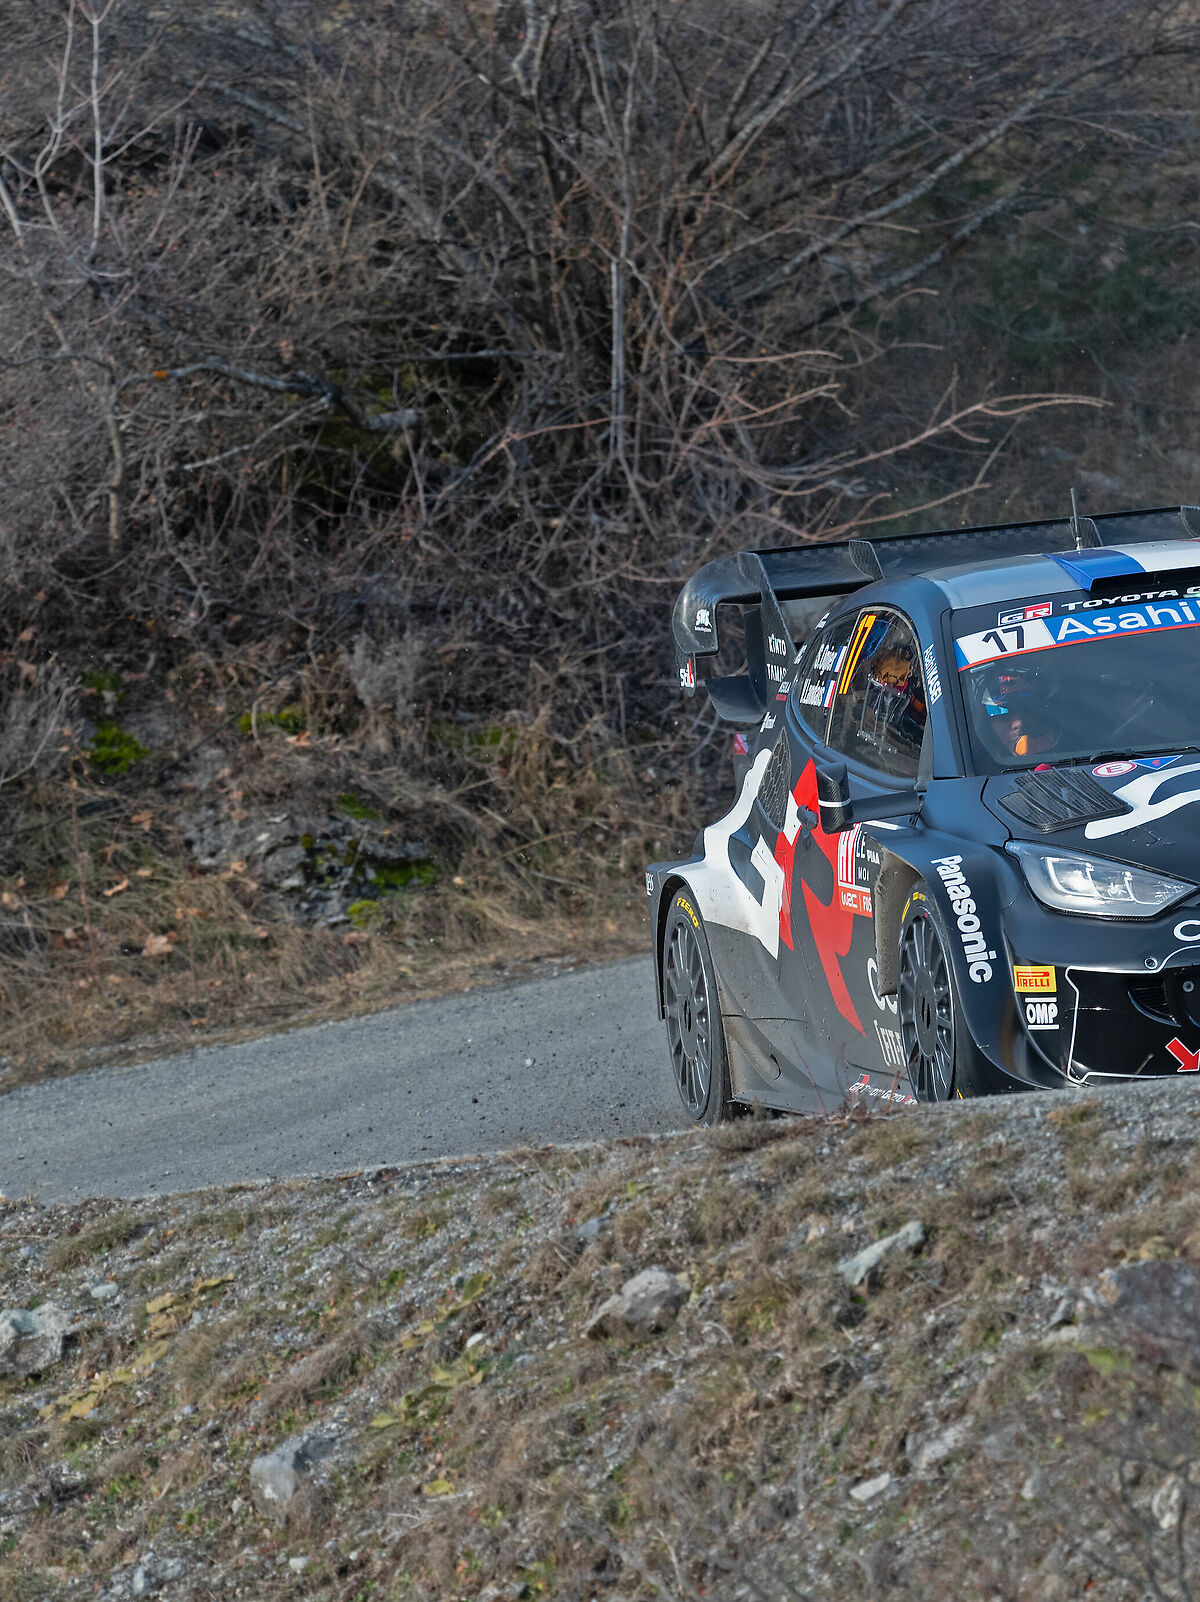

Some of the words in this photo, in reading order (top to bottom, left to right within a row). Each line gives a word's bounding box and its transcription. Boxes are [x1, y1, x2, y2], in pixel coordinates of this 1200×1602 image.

[1061, 589, 1178, 611] TOYOTA
[999, 605, 1051, 625] GR
[982, 625, 1025, 653] 17
[930, 855, 998, 984] Panasonic
[1016, 971, 1050, 988] PIRELLI
[1026, 1003, 1058, 1025] OMP
